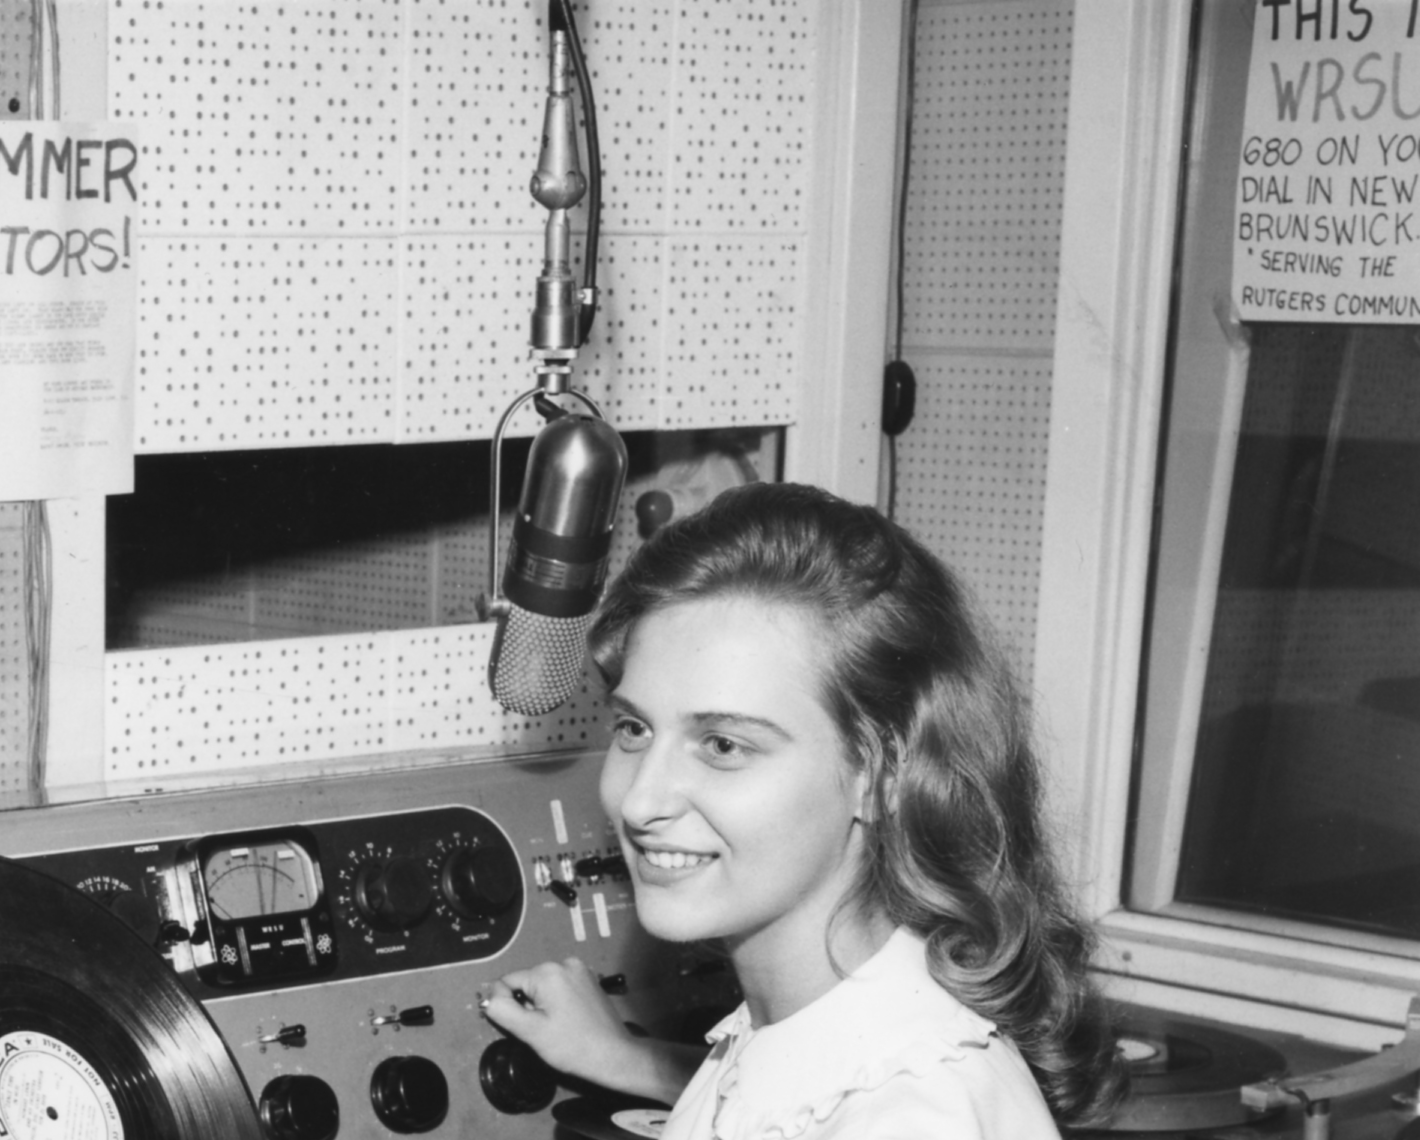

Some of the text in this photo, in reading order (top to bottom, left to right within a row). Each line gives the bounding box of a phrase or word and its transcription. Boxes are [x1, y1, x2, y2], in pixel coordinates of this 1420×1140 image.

[1262, 0, 1373, 41] THIS
[1270, 52, 1420, 123] WRSU
[1243, 134, 1420, 166] 680 ON YO
[1242, 174, 1418, 207] DIAL IN NEW
[1359, 256, 1397, 278] THE
[1242, 286, 1326, 312] RUTGERS
